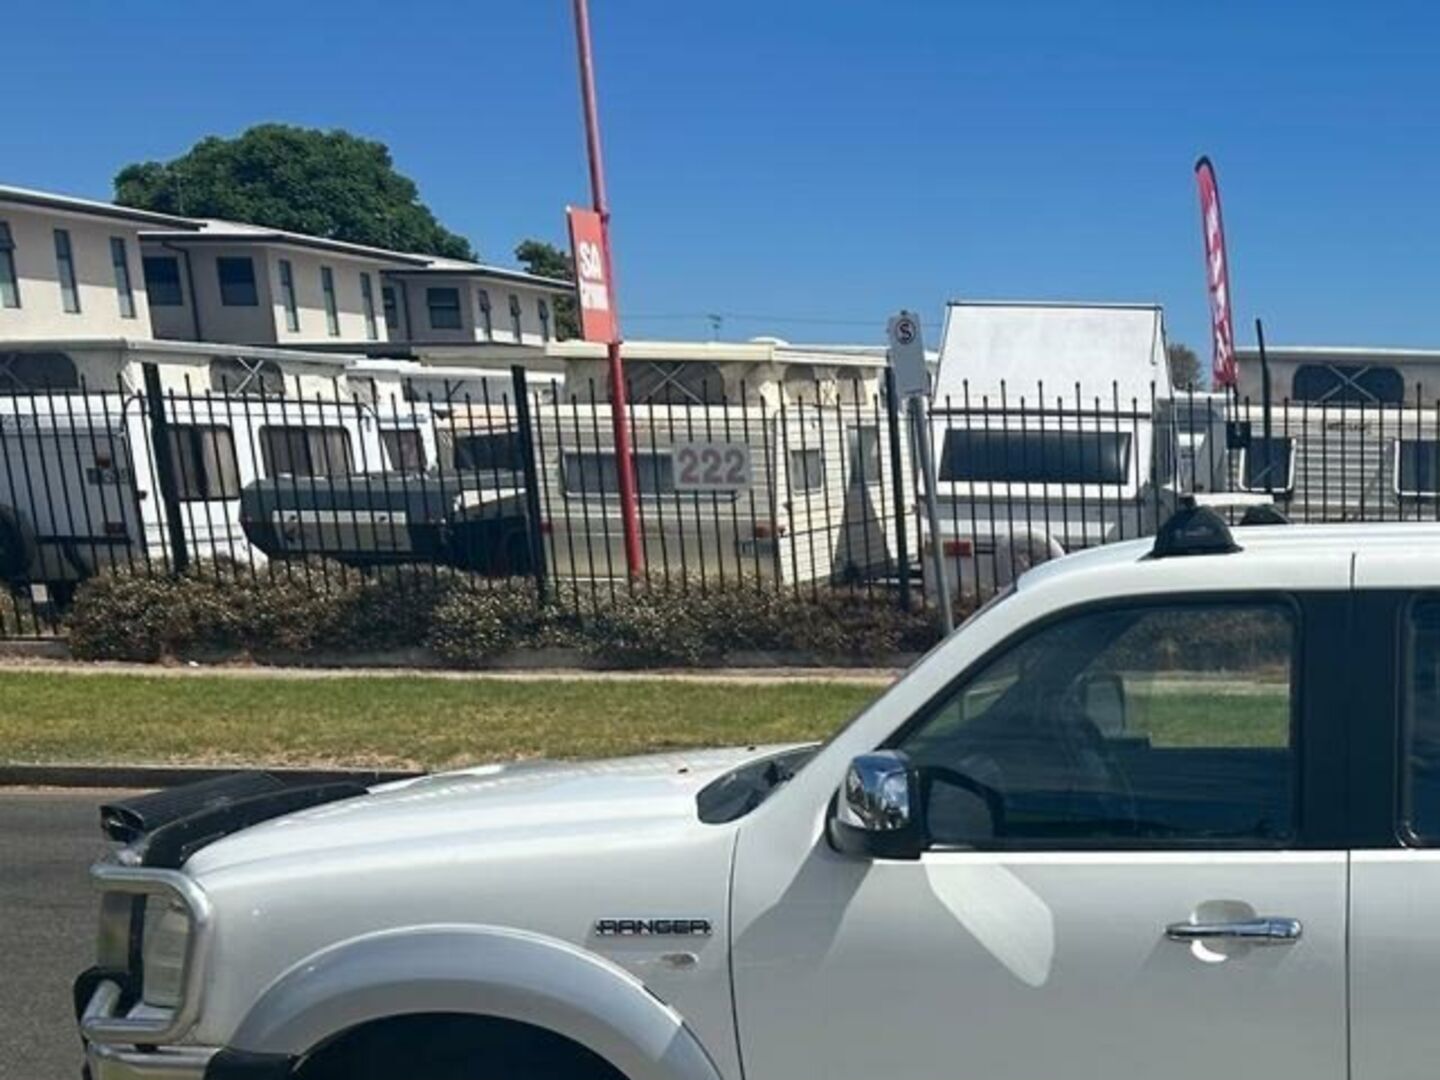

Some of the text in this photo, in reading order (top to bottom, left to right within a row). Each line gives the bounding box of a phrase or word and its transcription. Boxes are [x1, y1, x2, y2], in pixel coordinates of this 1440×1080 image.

[579, 241, 604, 279] SA
[677, 448, 746, 486] 222
[596, 917, 713, 937] RANGER
